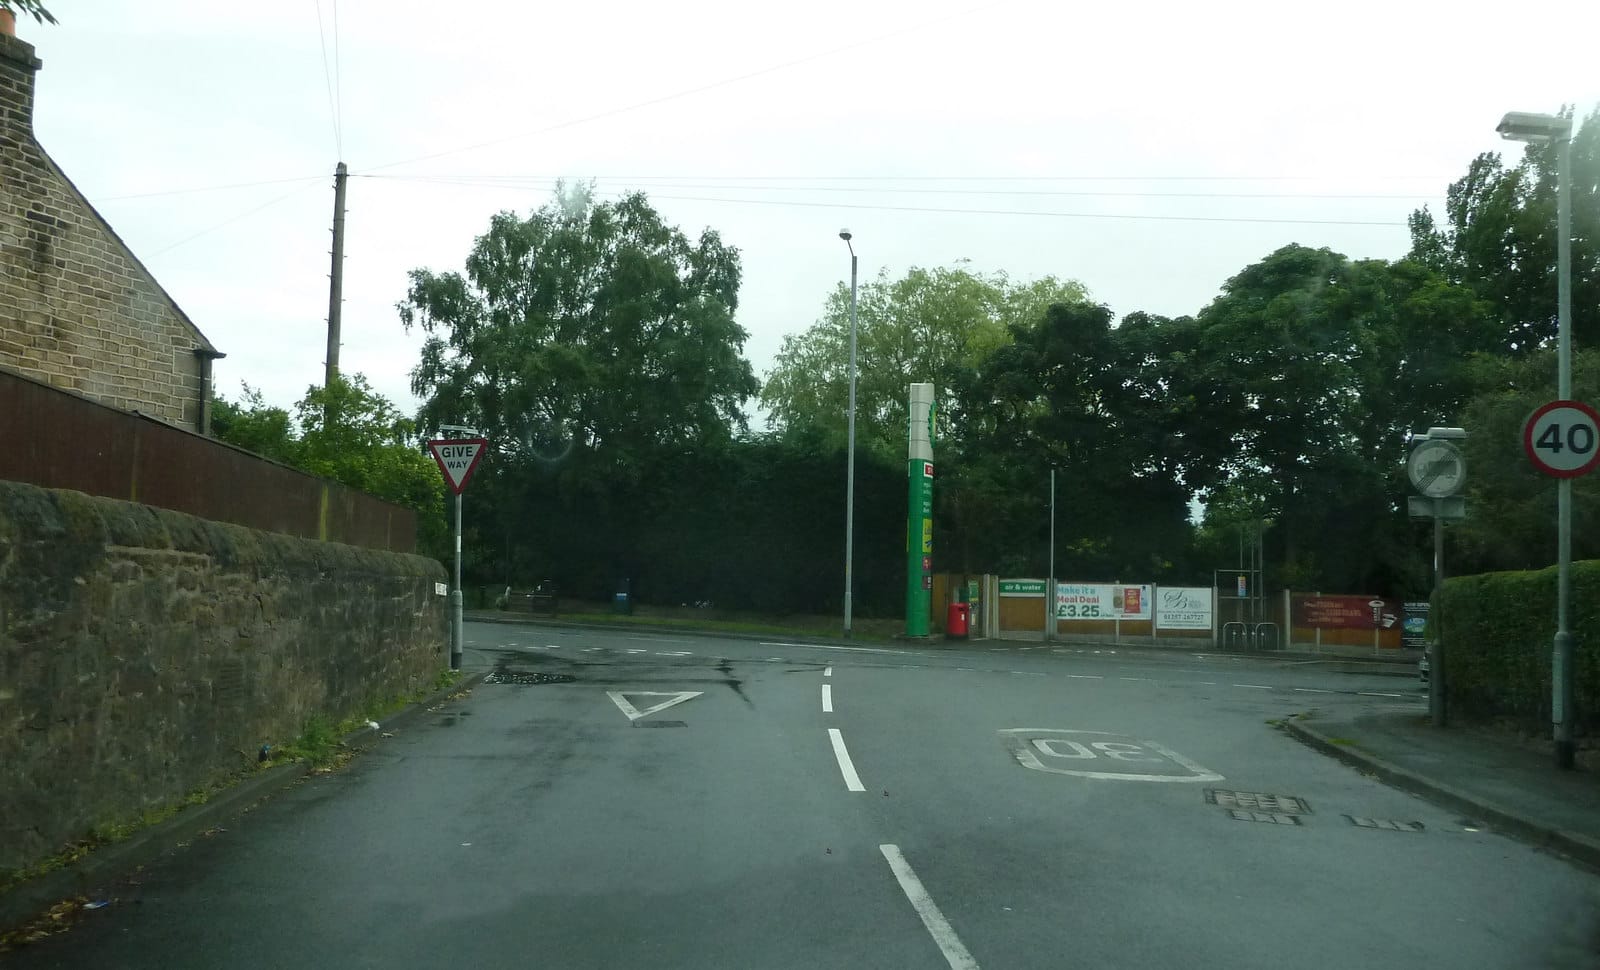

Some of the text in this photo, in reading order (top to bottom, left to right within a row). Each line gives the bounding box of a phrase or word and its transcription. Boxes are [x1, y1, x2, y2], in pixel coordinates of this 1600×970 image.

[1536, 423, 1594, 454] 40
[442, 446, 473, 458] GIVE
[447, 460, 468, 469] WAY
[1056, 586, 1080, 595] Make
[1056, 595, 1100, 604] Meal Deal
[1057, 604, 1100, 618] £3.25
[1032, 739, 1163, 762] 30
